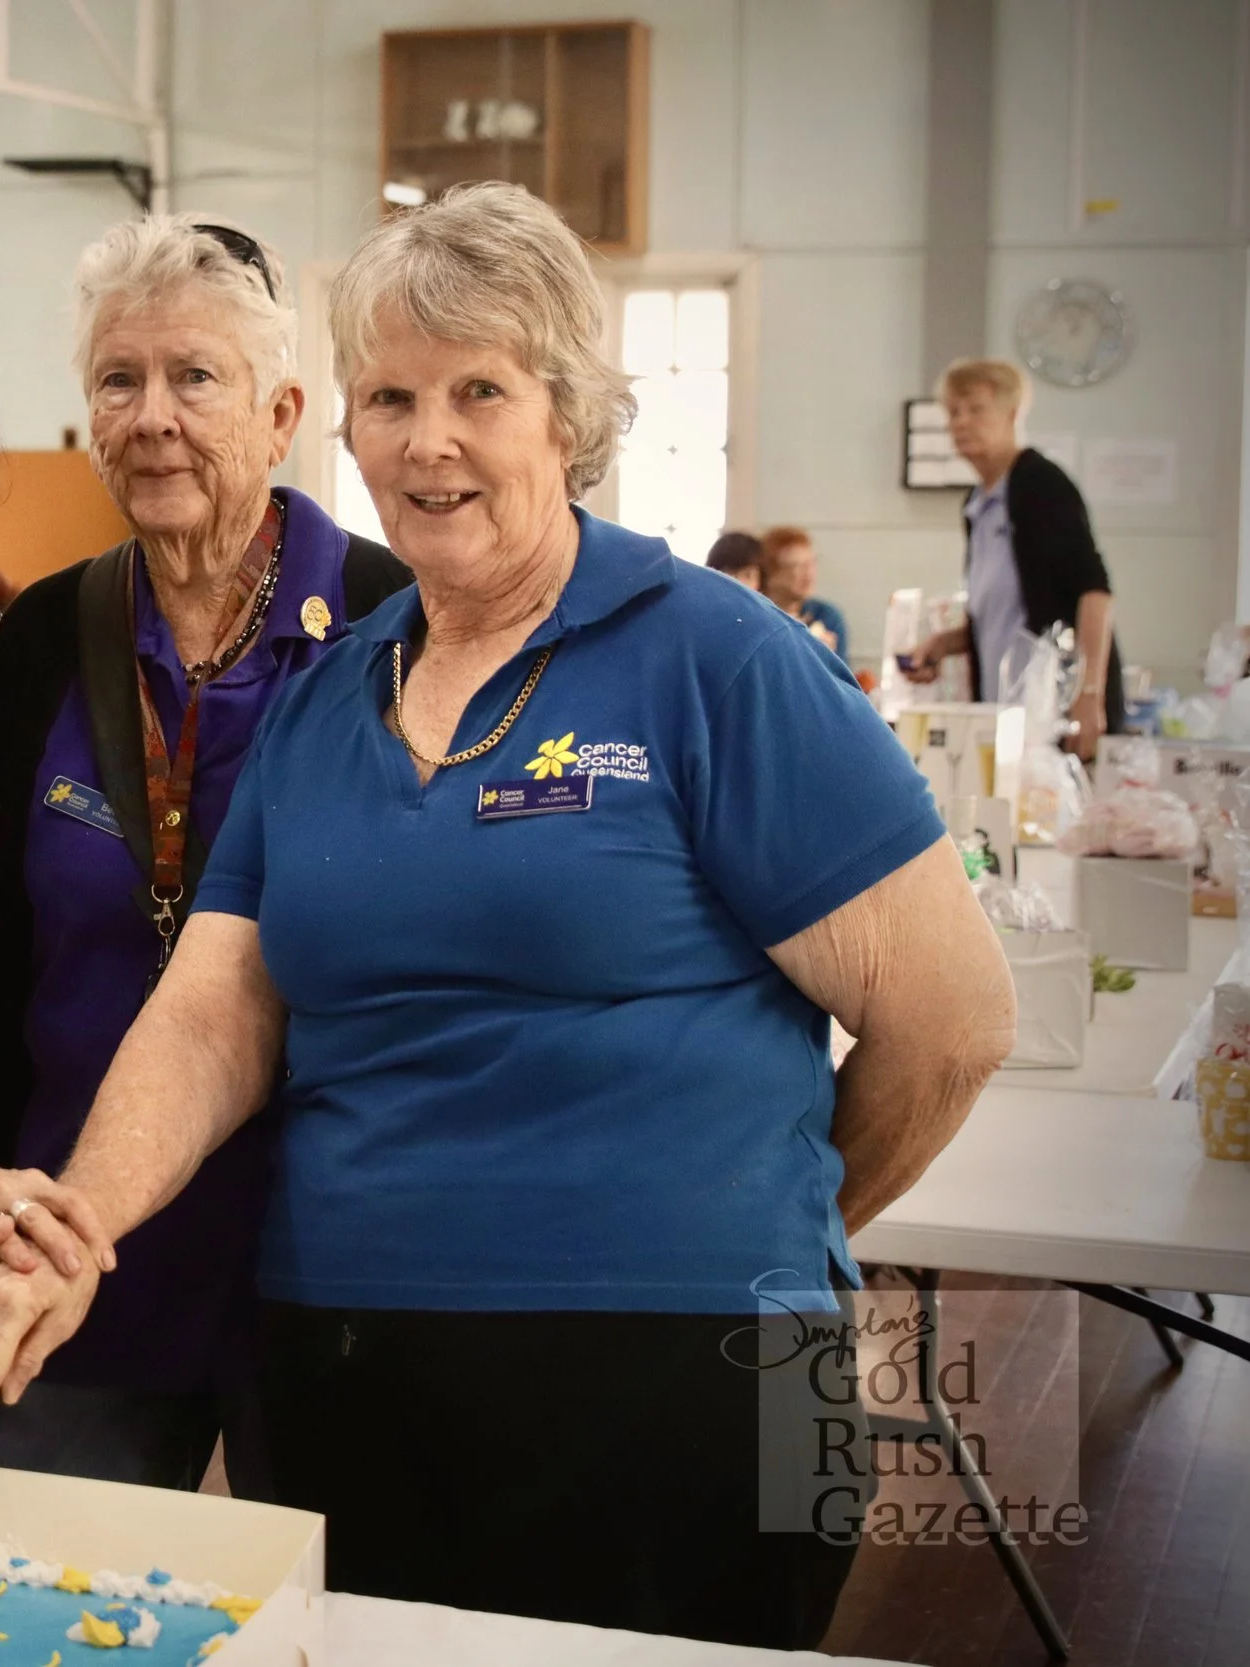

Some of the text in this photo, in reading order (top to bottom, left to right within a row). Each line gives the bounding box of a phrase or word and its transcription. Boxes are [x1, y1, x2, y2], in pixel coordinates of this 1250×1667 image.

[576, 756, 648, 770] Council
[547, 786, 569, 794] Jane
[537, 794, 578, 804] VOLUNTEER
